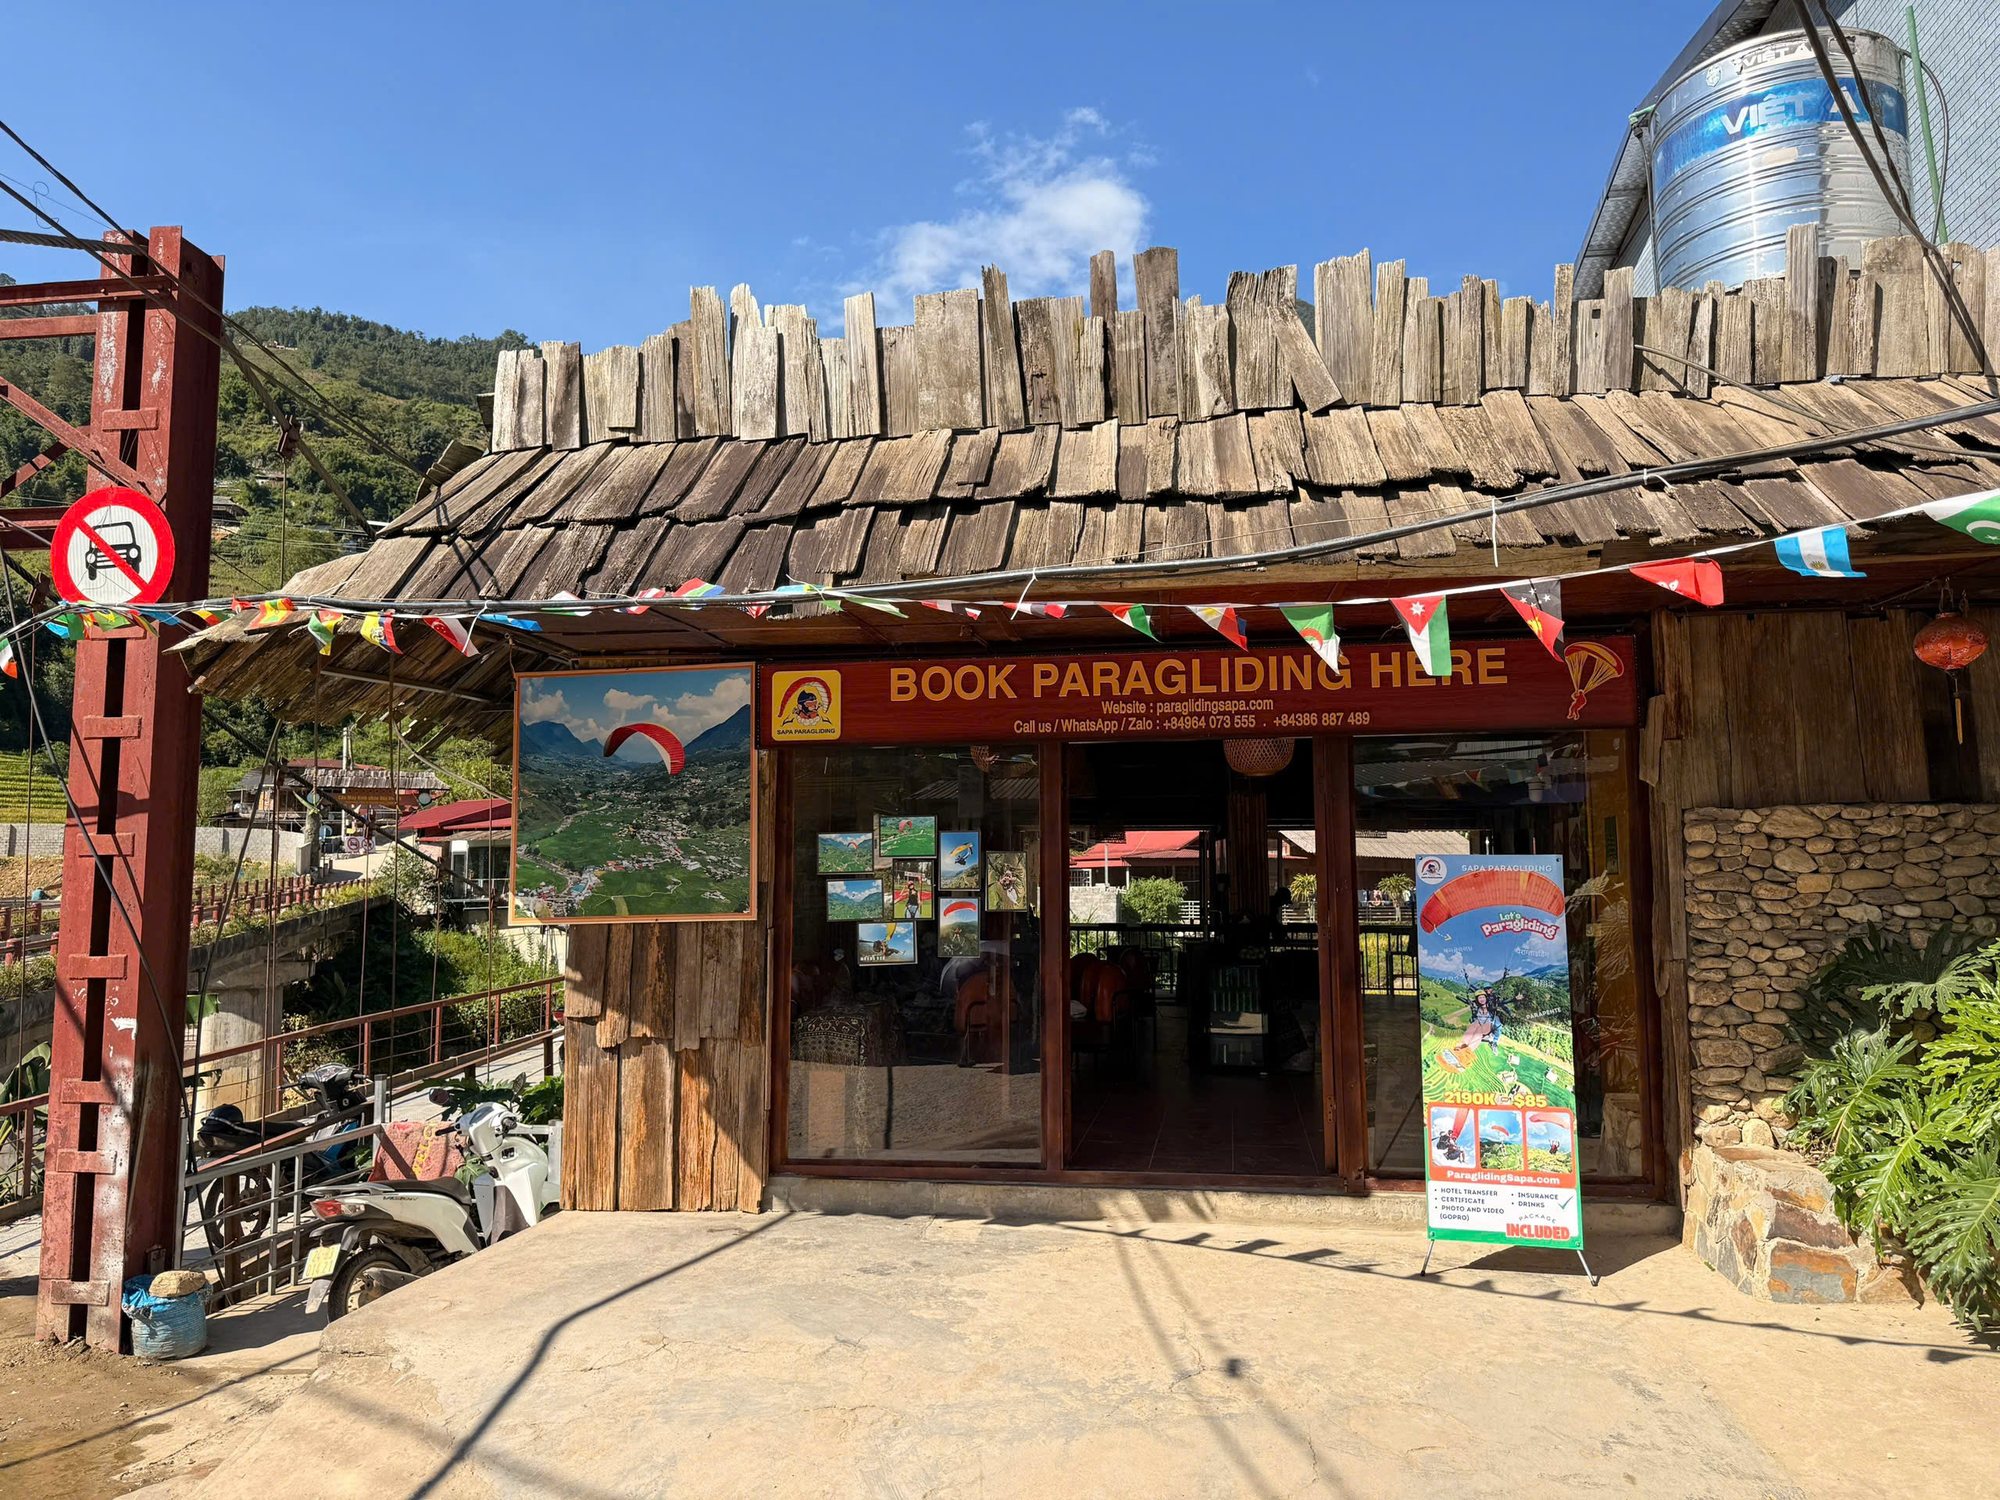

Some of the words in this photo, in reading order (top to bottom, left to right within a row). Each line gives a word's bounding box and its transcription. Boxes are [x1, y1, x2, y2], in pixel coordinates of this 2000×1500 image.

[890, 664, 1017, 702] BOOK
[1033, 654, 1351, 698] PARAGLIDING
[1371, 647, 1508, 688] HERE
[1101, 700, 1146, 714] Website
[1156, 699, 1274, 716] paraglidingsapa.com
[1013, 719, 1035, 733] Call
[1038, 722, 1052, 733] us
[1061, 718, 1118, 733] WhatsApp
[1128, 717, 1153, 731] Zalo
[1163, 715, 1206, 730] +84964
[1209, 715, 1231, 729] 073
[1234, 714, 1256, 728] 555
[1273, 713, 1318, 727] +84386
[1321, 712, 1344, 726] 887
[1347, 711, 1370, 725] 489
[1462, 864, 1486, 872] SAPA
[1488, 864, 1552, 872] PARAGLIDING
[1483, 918, 1557, 938] Paragliding
[1447, 1170, 1560, 1185] ParaglidingSapa.com
[1440, 1187, 1462, 1195] HOTEL
[1463, 1188, 1498, 1196] TRANSFER
[1518, 1192, 1558, 1200] INSURANCE
[1440, 1196, 1485, 1205] CERTIFICATE
[1518, 1200, 1545, 1208] DRINKS
[1441, 1204, 1465, 1212] PHOTO
[1439, 1213, 1470, 1222] (GOPRO)
[1519, 1213, 1557, 1224] PACKAGE
[1506, 1223, 1570, 1240] INCLUDED
